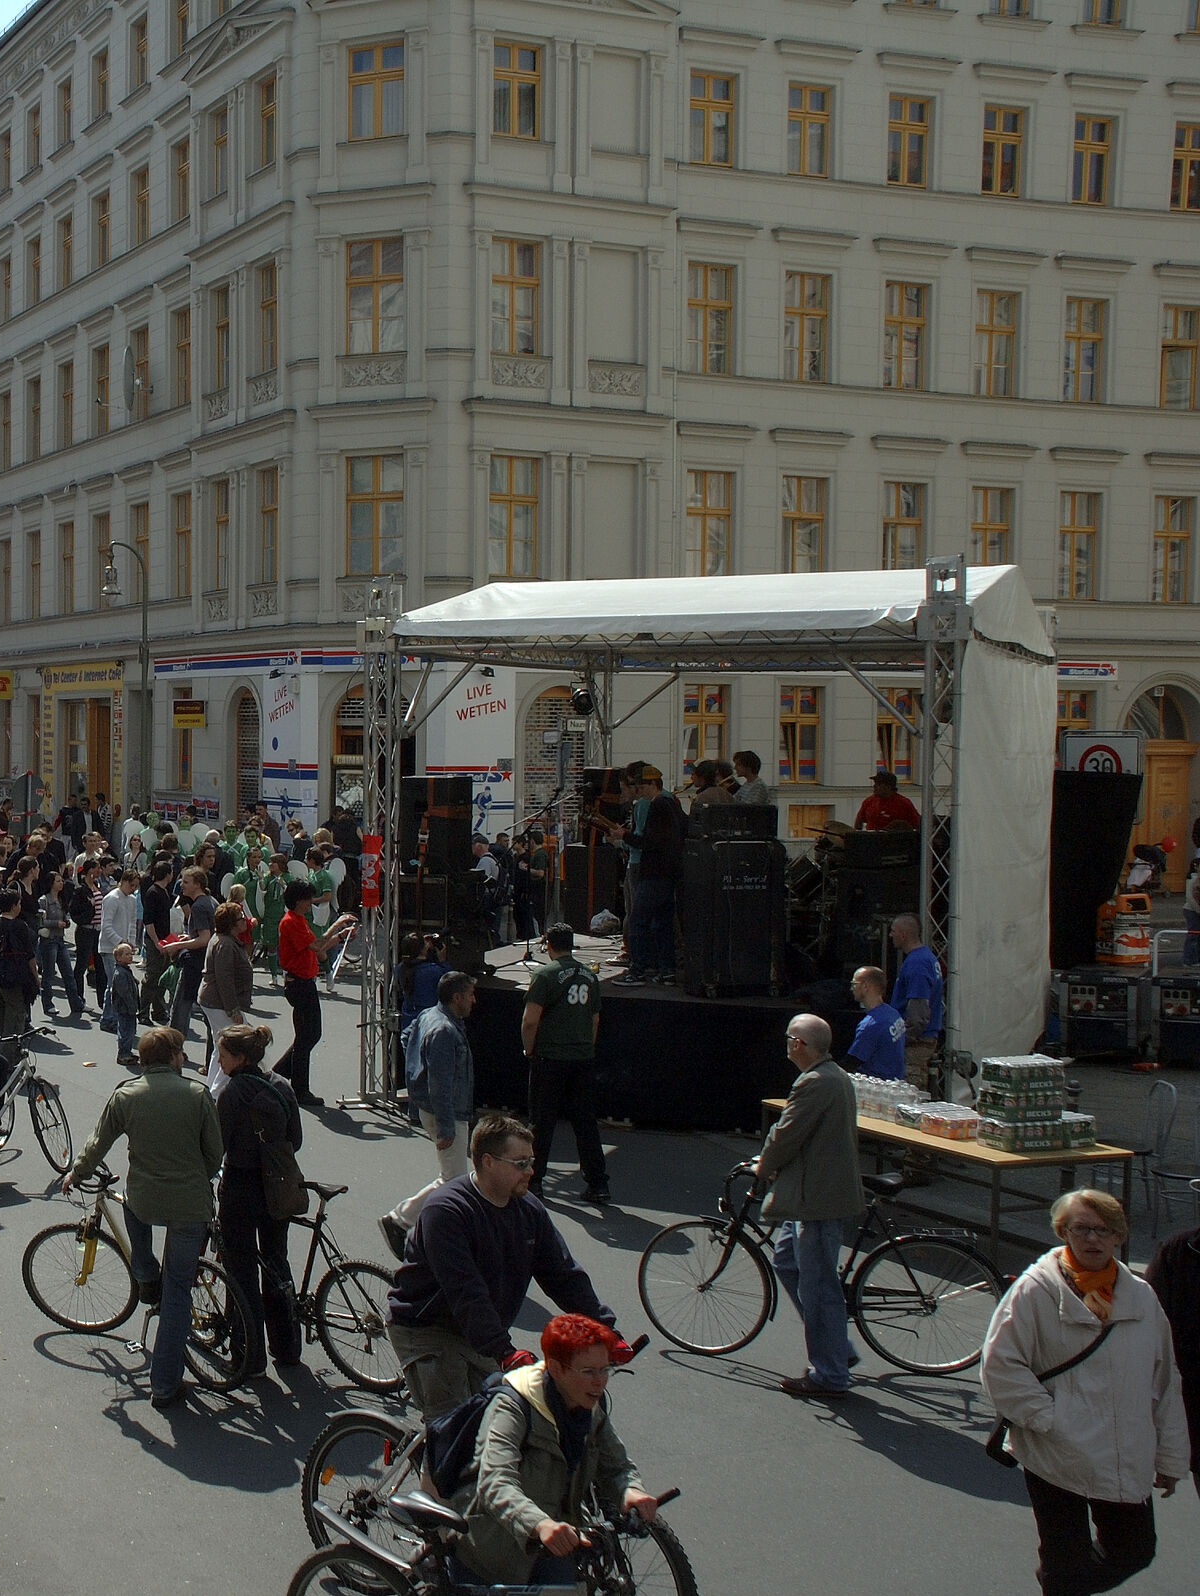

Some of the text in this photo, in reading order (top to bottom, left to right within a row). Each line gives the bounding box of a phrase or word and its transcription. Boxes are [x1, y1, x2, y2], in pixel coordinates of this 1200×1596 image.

[274, 685, 288, 702] LIVE
[467, 683, 492, 700] LIVE
[268, 700, 295, 723] WETTEN
[456, 699, 507, 721] WETTEN
[1088, 757, 1114, 773] 30
[567, 983, 589, 1005] 36
[1026, 1109, 1052, 1118] BECK'S
[1024, 1140, 1051, 1149] BECK'S
